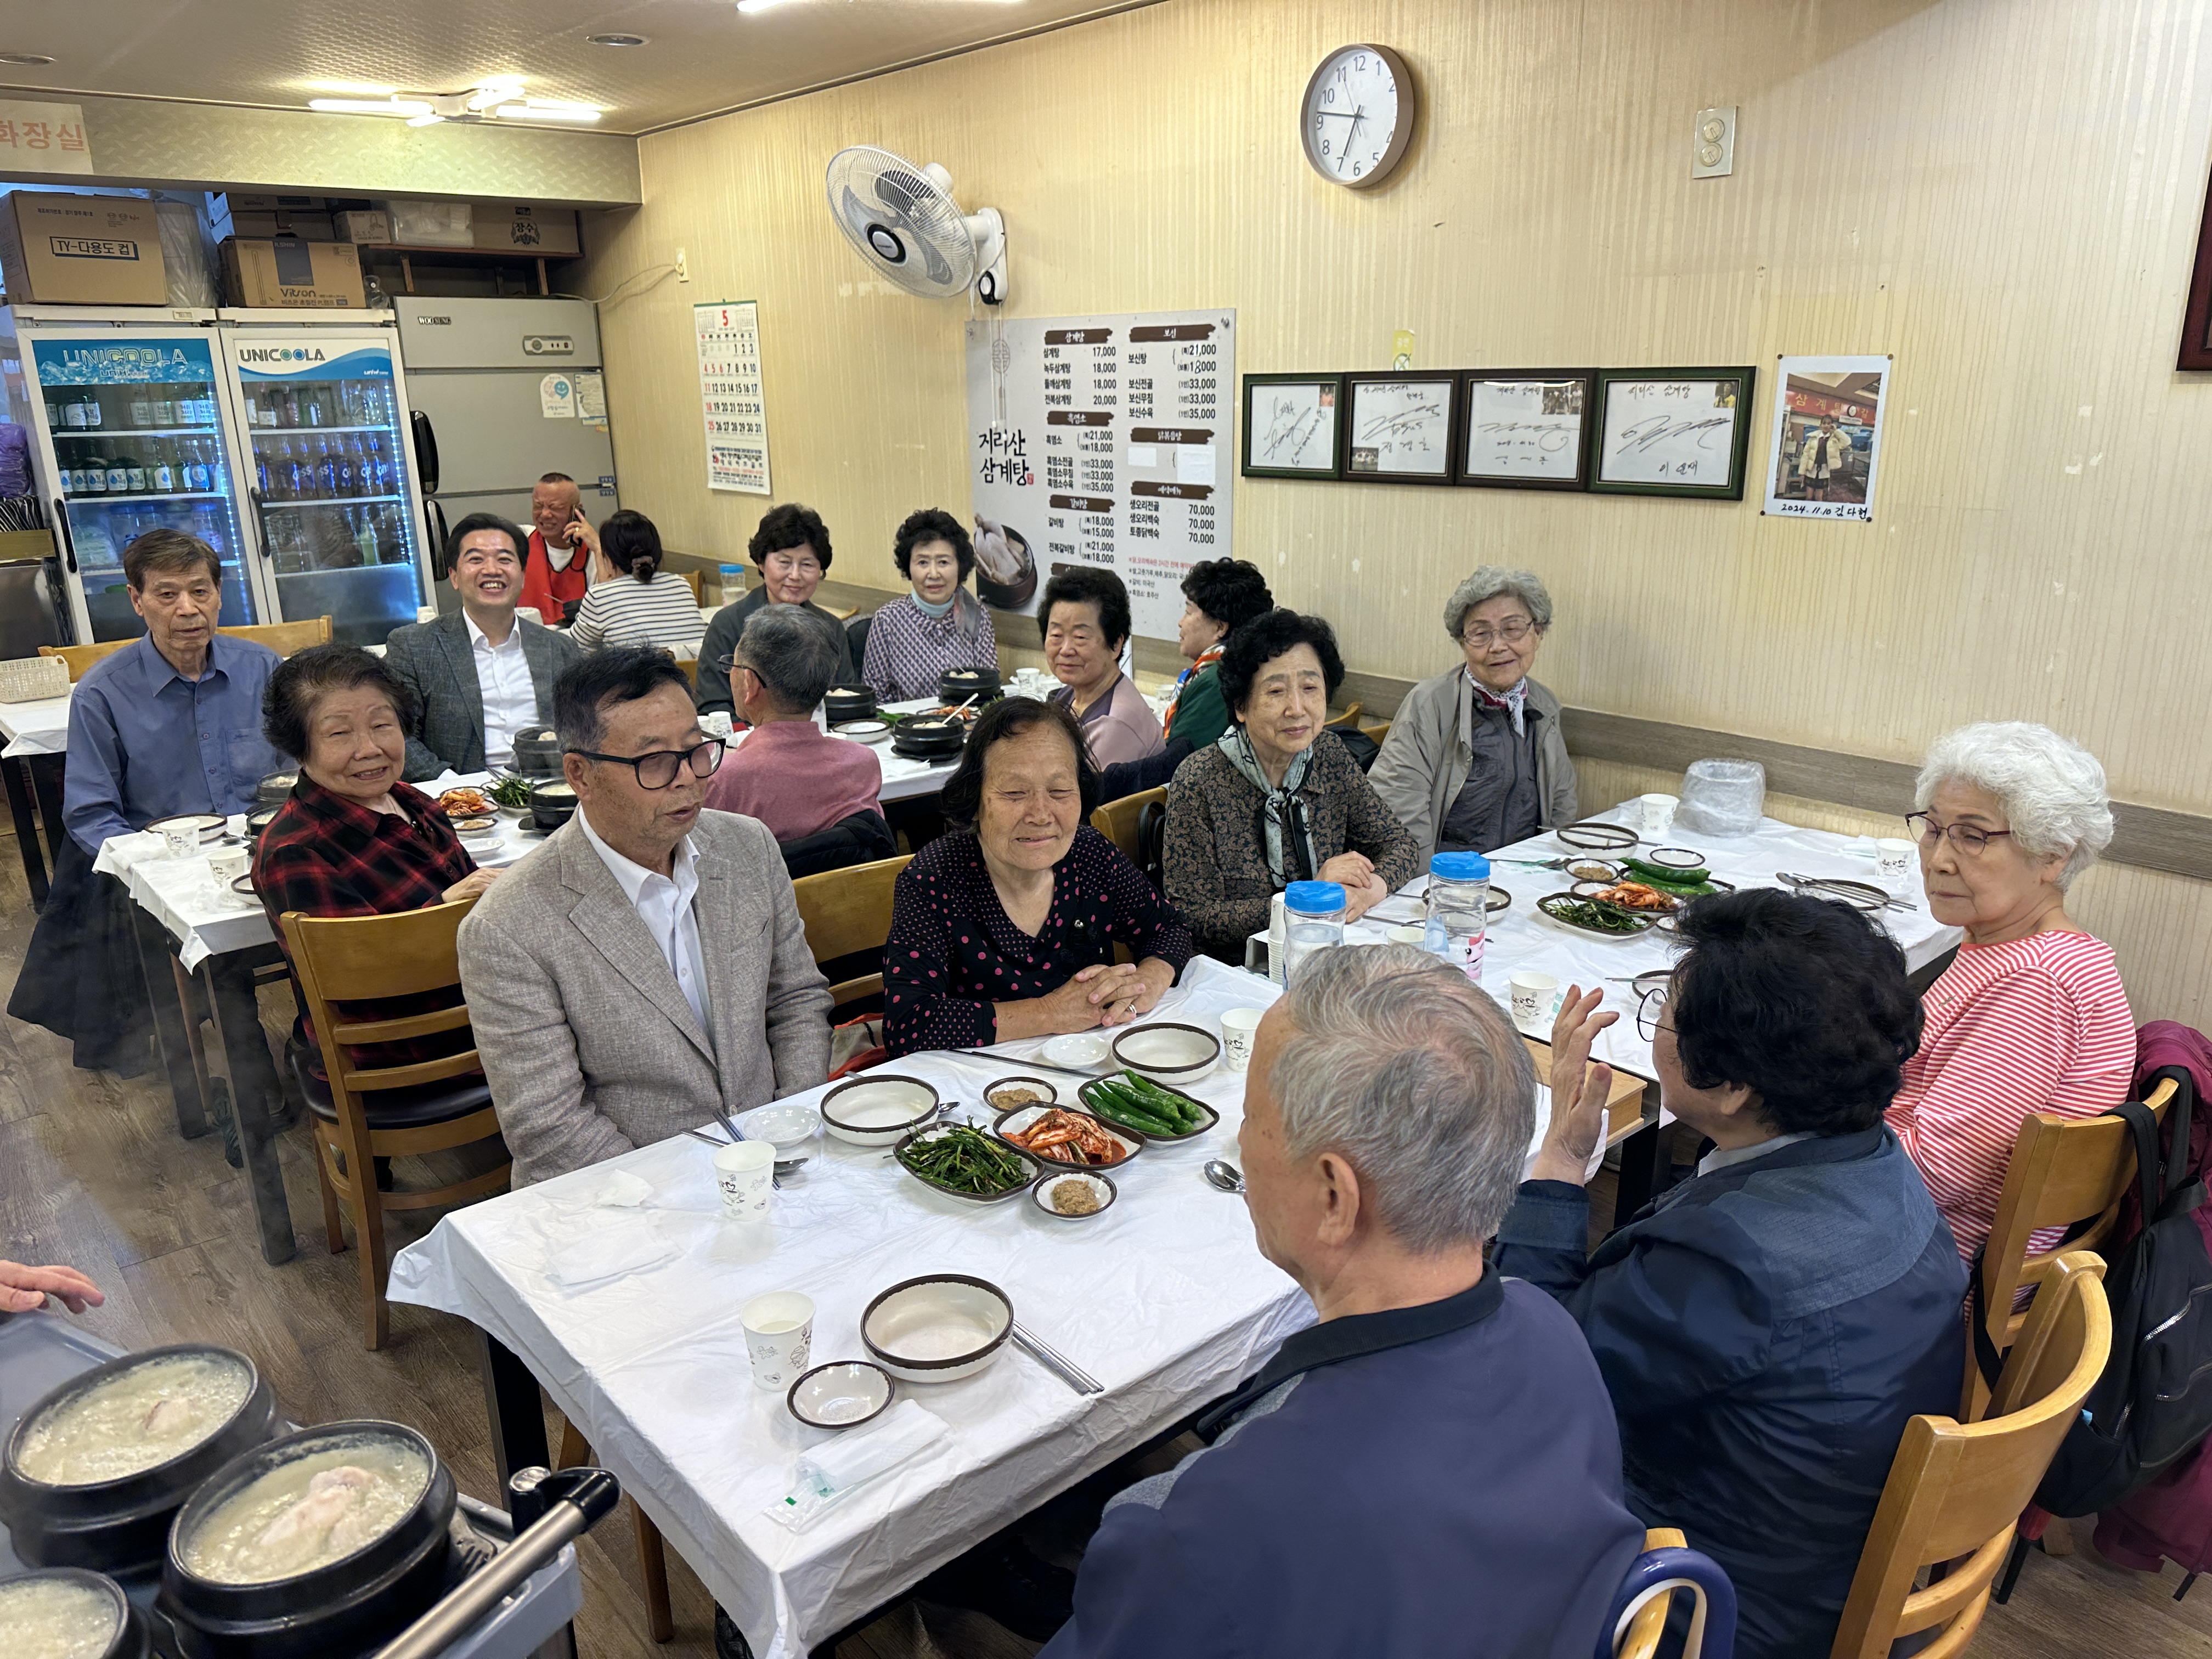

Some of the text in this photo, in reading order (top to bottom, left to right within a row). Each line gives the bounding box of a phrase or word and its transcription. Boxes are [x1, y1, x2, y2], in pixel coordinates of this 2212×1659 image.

[1353, 55, 1365, 72] 12
[1375, 60, 1381, 76] 1
[1336, 66, 1346, 82] 11
[1322, 88, 1335, 104] 10
[1317, 115, 1324, 130] 9
[0, 120, 84, 151] 화장실
[1322, 139, 1330, 155] 8
[1336, 156, 1344, 172] 7
[1353, 161, 1361, 176] 6
[57, 240, 130, 255] TY-다용도 컵
[722, 310, 729, 326] 5
[239, 348, 326, 362] UNICOOLA
[735, 343, 753, 354] 1 2 3
[1043, 347, 1116, 358] 삼계탕 17,000
[63, 349, 188, 366] UNICOOLA
[1128, 353, 1147, 364] 보신탕
[704, 363, 756, 374] 4 5 6 7 8 9 10
[1044, 363, 1116, 374] 녹두삼계탕 18,000
[705, 383, 757, 394] 11 12 13 14 15 16 17
[1093, 379, 1116, 390] 18,000
[1129, 379, 1153, 389] 보신전골
[1045, 394, 1116, 406] 전복삼계탕 20,000
[1129, 393, 1153, 404] 보신무침
[706, 402, 760, 413] 18 19 20 21 22 23 24
[1129, 408, 1153, 419] 보신수육
[708, 421, 761, 433] 25 26 27 28 29 30 31
[979, 428, 1026, 456] 지리산
[1046, 435, 1062, 445] 흑염소
[1047, 456, 1073, 467] 흑염소전골
[979, 457, 1029, 486] 삼계탕
[1047, 467, 1073, 478] 흑염소무침
[1048, 478, 1074, 490] 흑염소수육
[1130, 500, 1214, 516] 생오리전골 70,000
[1048, 517, 1064, 528] 갈비탕
[1130, 513, 1214, 530] 생오리백숙 70,000
[1130, 527, 1214, 544] 토종닭백숙 70,000
